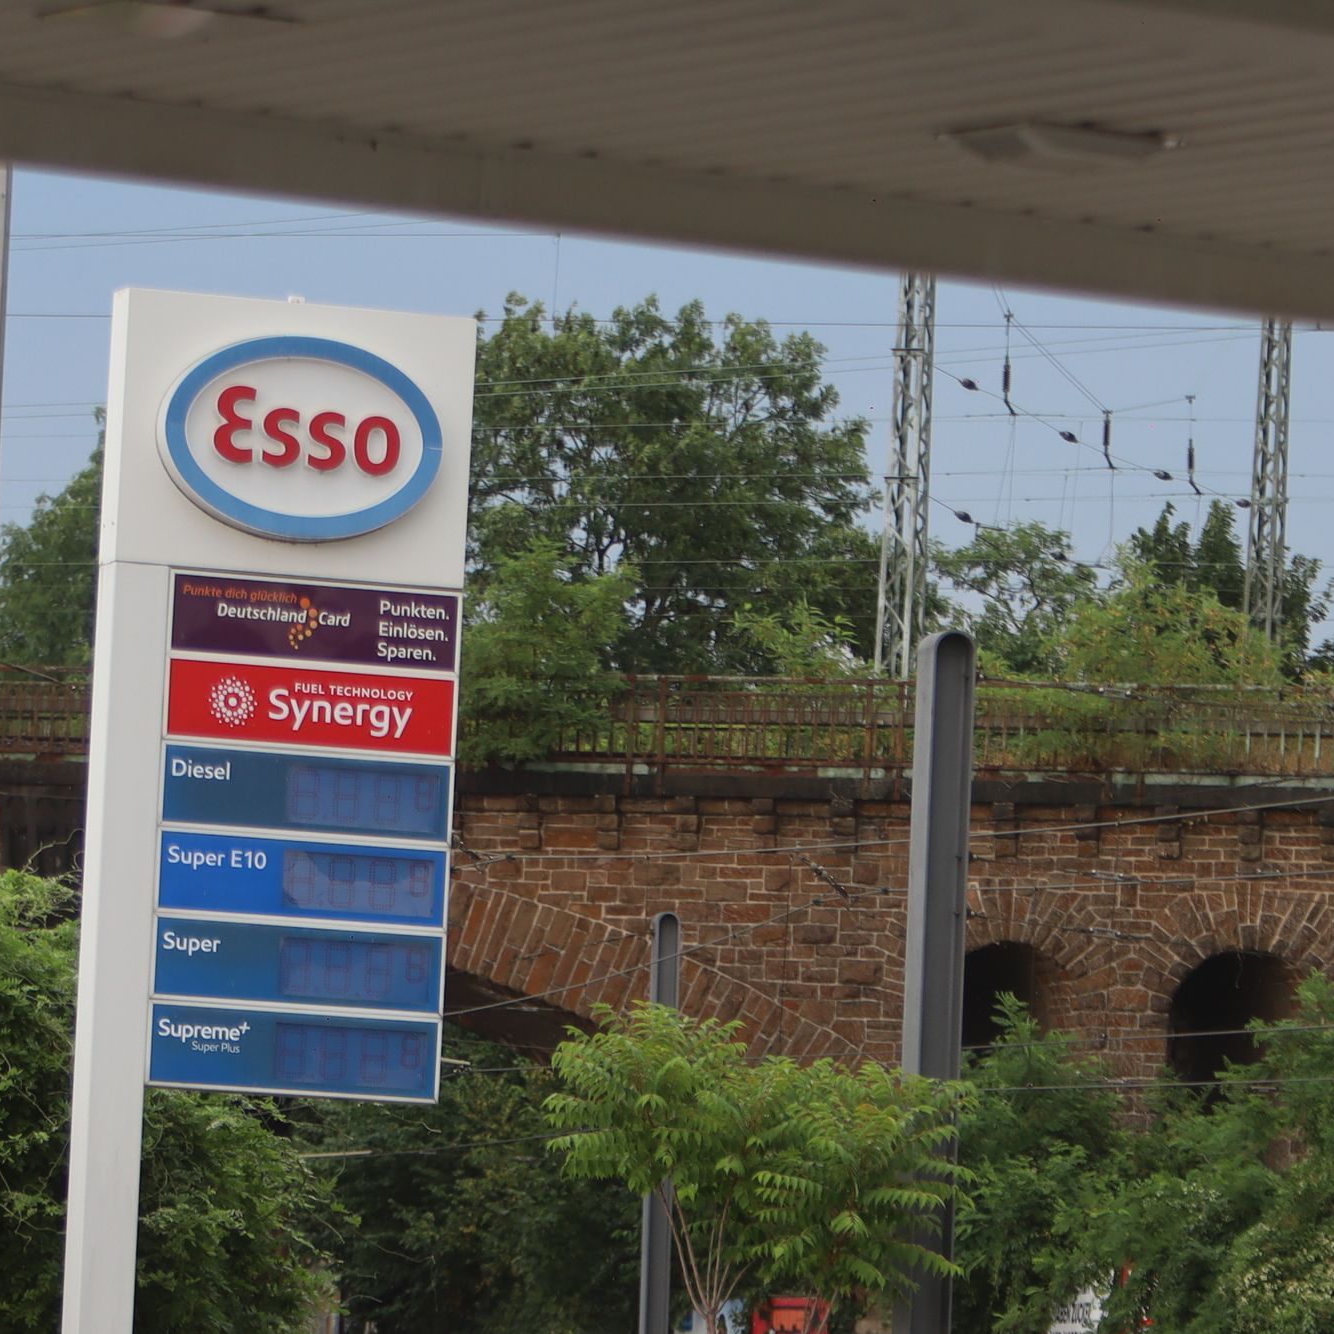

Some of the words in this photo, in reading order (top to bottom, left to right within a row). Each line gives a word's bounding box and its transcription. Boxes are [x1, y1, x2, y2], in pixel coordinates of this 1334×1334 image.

[213, 386, 400, 476] Esso
[183, 584, 219, 599] Punkte
[221, 588, 247, 601] dich
[249, 589, 298, 605] glücklich
[217, 604, 307, 624] Deutschland
[318, 611, 351, 627] Card
[380, 601, 450, 621] Punkten.
[378, 621, 449, 642] Einlösen.
[377, 643, 437, 662] Sparen.
[294, 683, 326, 695] FUEL
[329, 684, 414, 701] TECHNOLOGY
[268, 689, 413, 738] Synergy
[171, 759, 231, 781] Diesel
[167, 846, 225, 869] Super
[231, 851, 267, 870] E10
[162, 932, 221, 956] Super
[191, 1040, 219, 1054] Super
[221, 1042, 240, 1054] Plus
